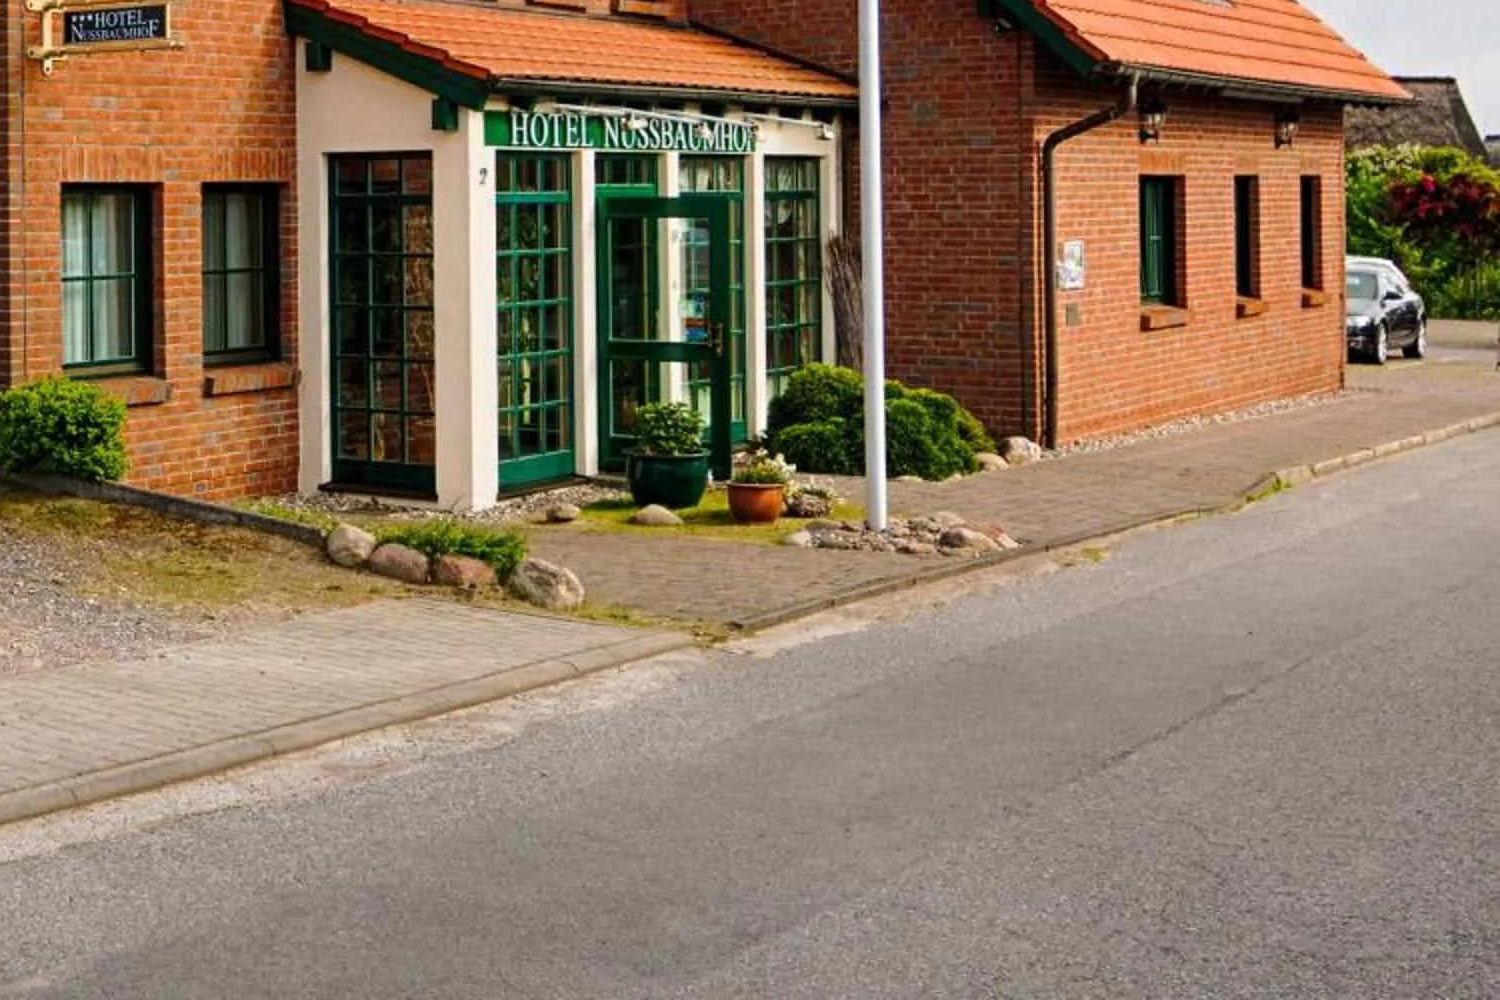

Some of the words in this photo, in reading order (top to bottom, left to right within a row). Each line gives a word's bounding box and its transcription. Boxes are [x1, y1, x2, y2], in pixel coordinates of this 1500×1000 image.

[95, 9, 147, 29] HOTEL
[510, 111, 596, 149] HOTEL
[479, 167, 488, 185] 2
